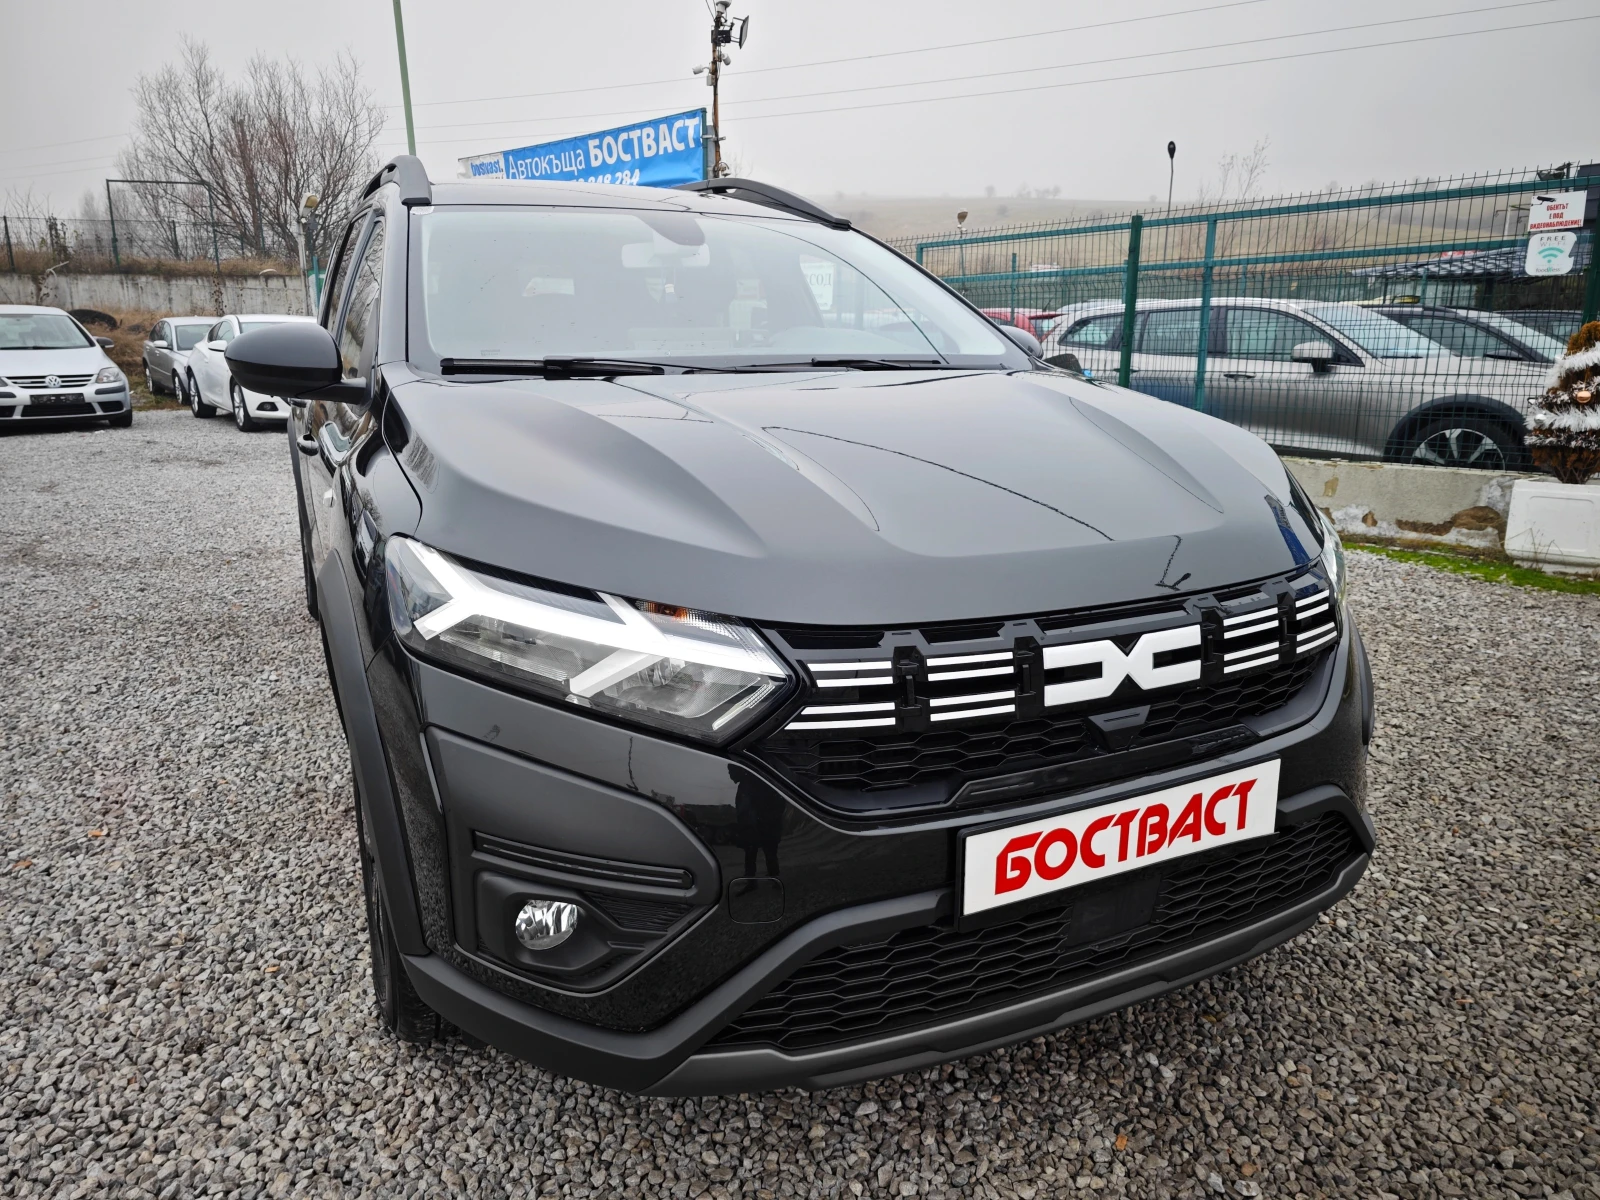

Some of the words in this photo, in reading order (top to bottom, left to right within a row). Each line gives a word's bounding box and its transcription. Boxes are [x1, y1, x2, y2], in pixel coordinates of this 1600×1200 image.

[508, 149, 585, 180] Автокъща
[588, 116, 700, 168] БОСТВАСТ
[614, 168, 640, 186] 284
[994, 778, 1258, 895] БОСТВАСТ
